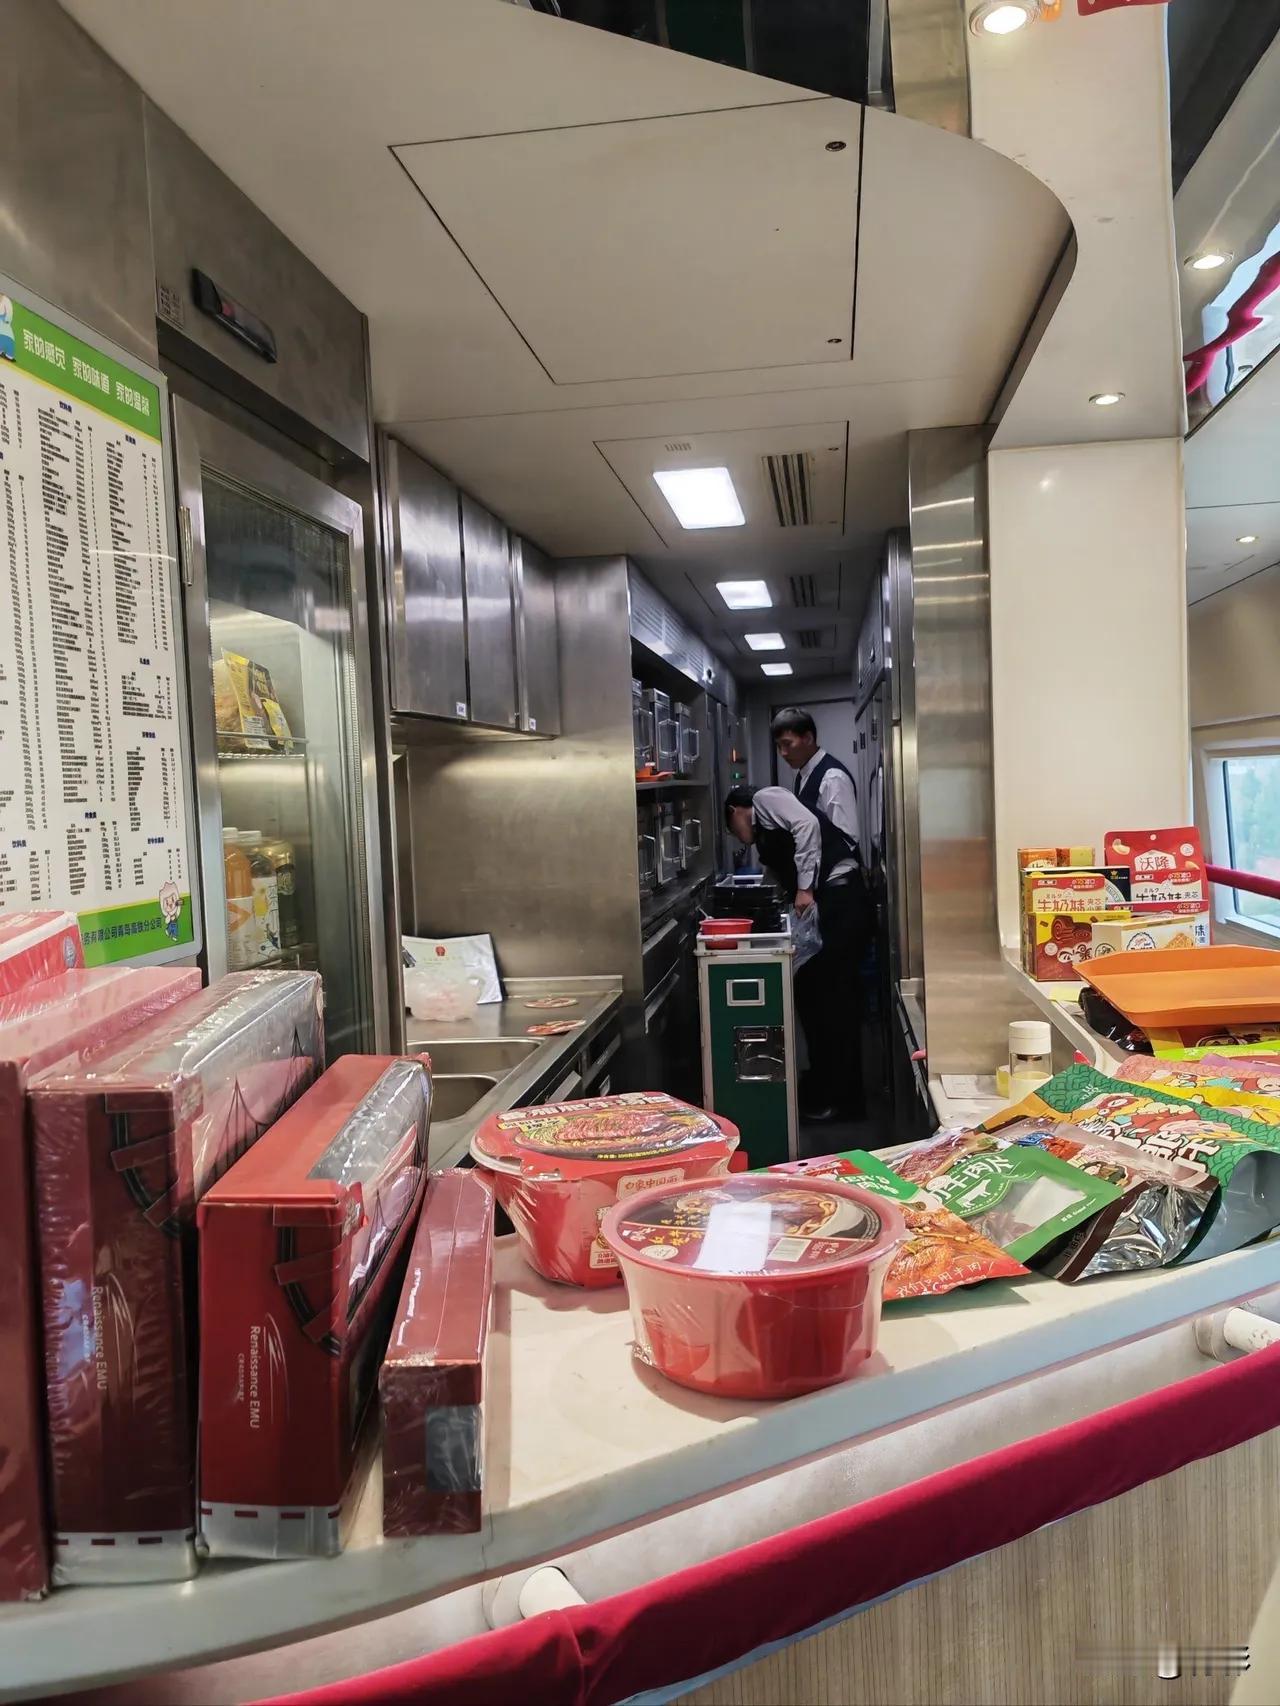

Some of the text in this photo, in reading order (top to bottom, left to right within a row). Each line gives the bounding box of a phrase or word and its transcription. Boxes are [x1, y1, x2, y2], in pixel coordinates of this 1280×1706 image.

[1139, 856, 1170, 871] 沃隆
[81, 917, 162, 945] 务有限公司青岛高铁分公司
[91, 1285, 108, 1390] Renaissance EMU
[249, 1325, 261, 1429] Renaissance EMU
